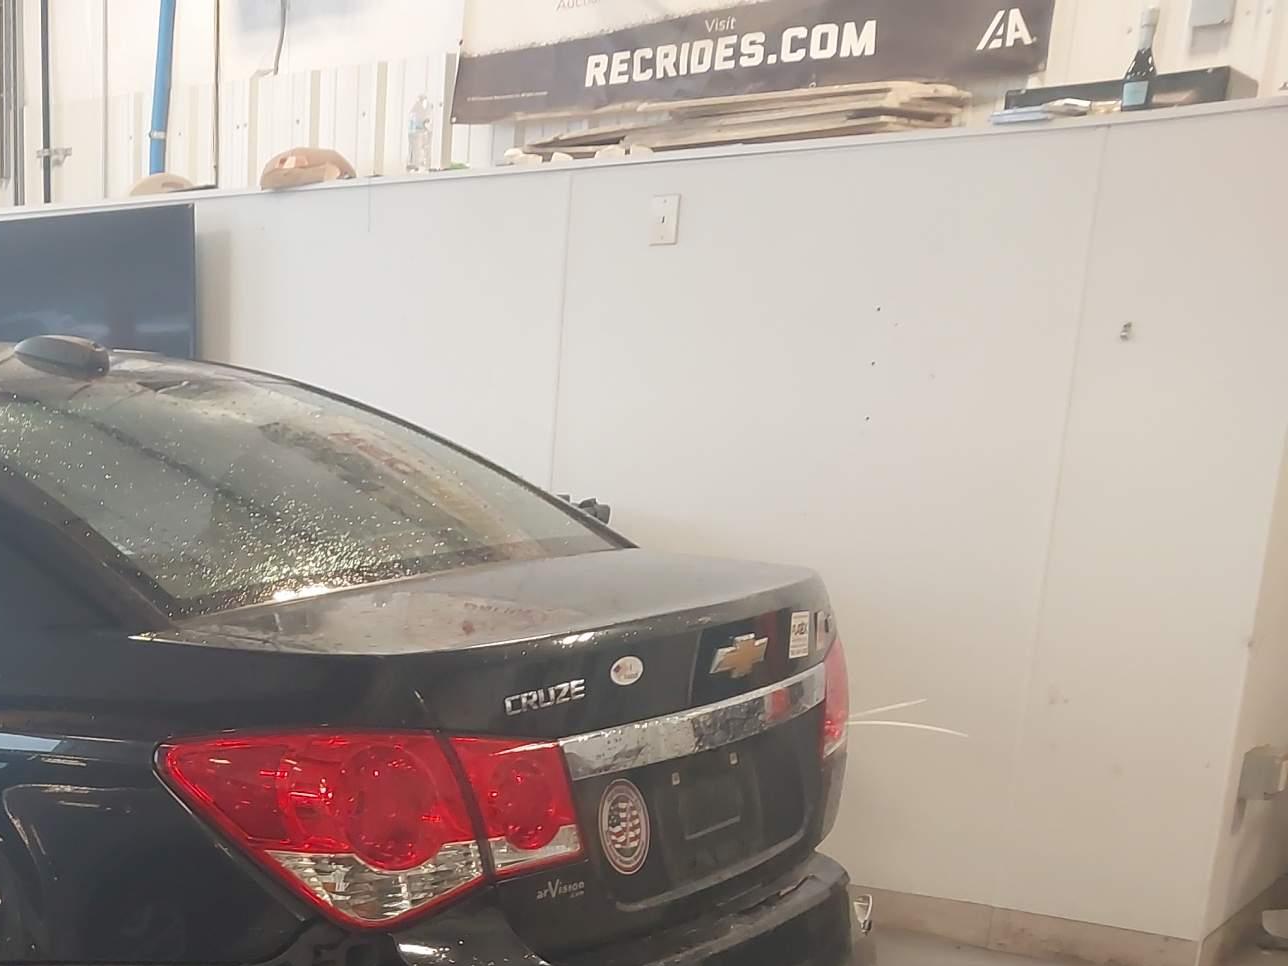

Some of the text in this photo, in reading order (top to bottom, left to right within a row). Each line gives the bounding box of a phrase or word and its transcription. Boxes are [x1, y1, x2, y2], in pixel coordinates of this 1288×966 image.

[704, 16, 737, 33] Visit
[585, 20, 877, 88] RECRIDES.COM
[505, 679, 585, 715] CRUZE
